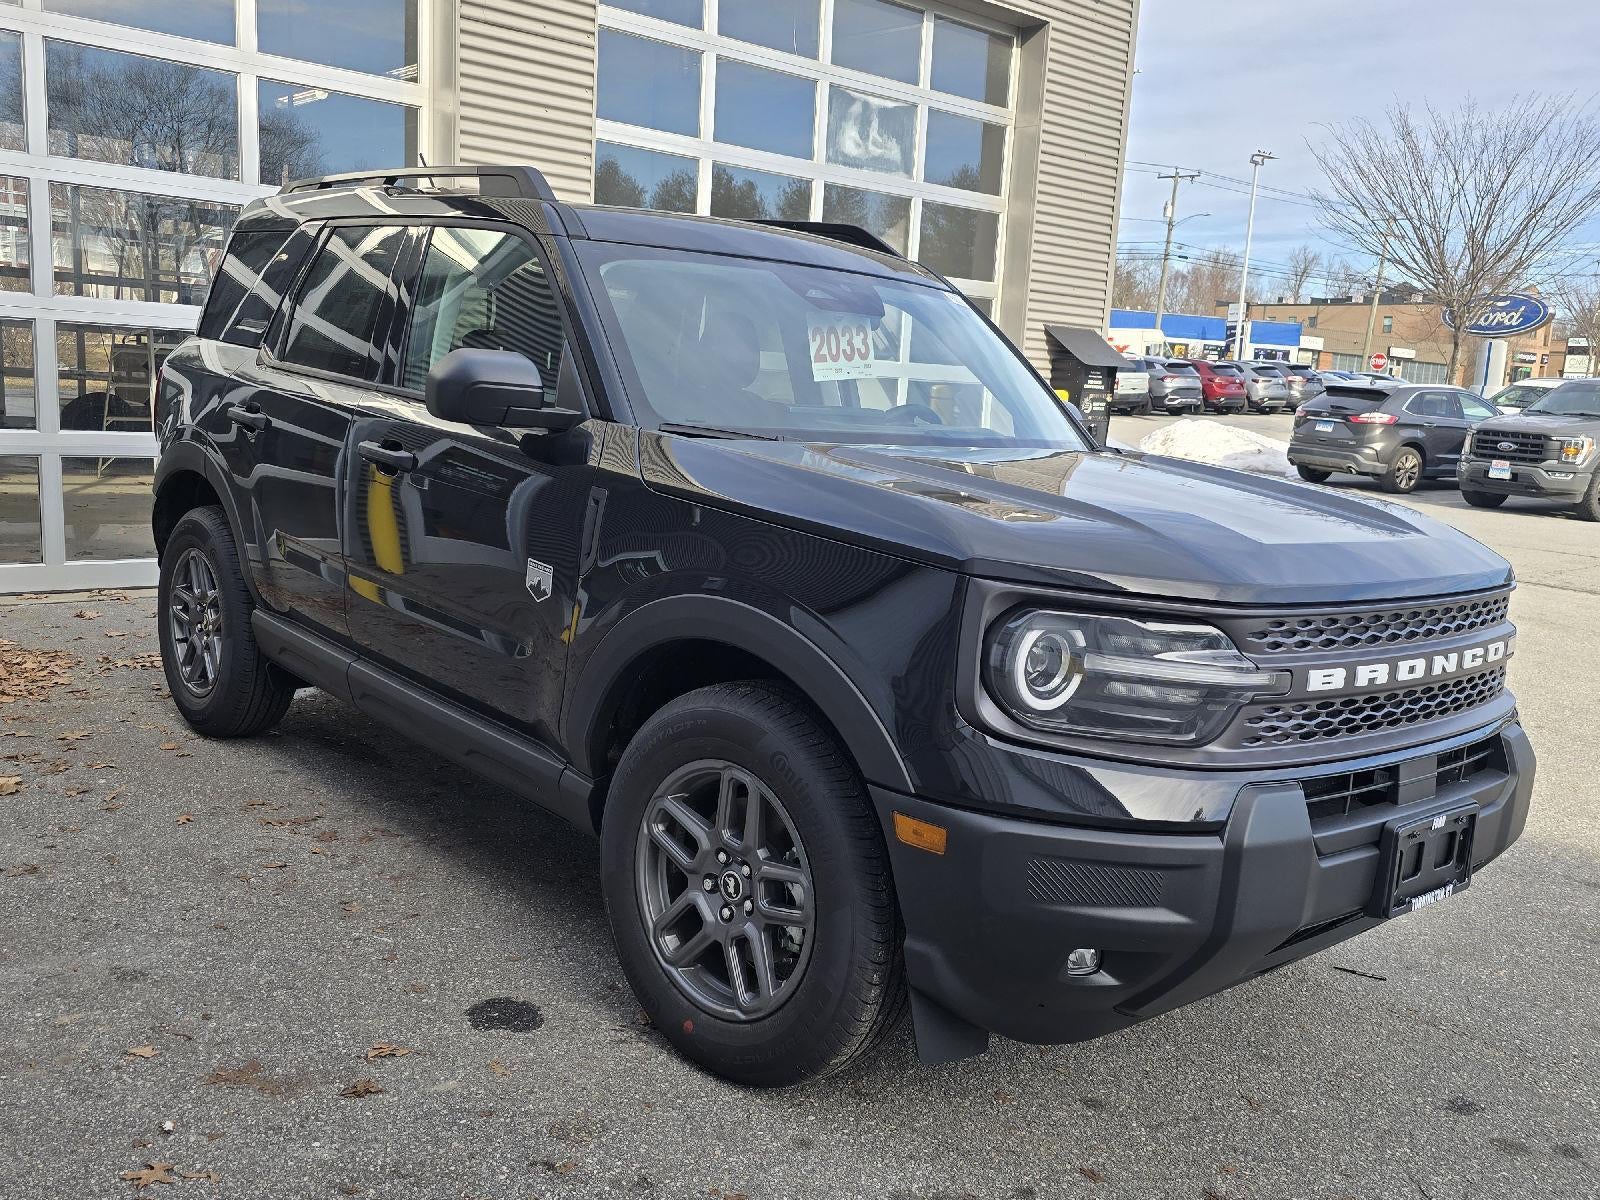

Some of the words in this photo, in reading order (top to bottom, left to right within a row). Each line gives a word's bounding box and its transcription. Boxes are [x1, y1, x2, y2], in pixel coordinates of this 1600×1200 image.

[812, 325, 870, 363] 2033
[1371, 357, 1387, 366] STOP
[1307, 641, 1505, 691] BRONCO
